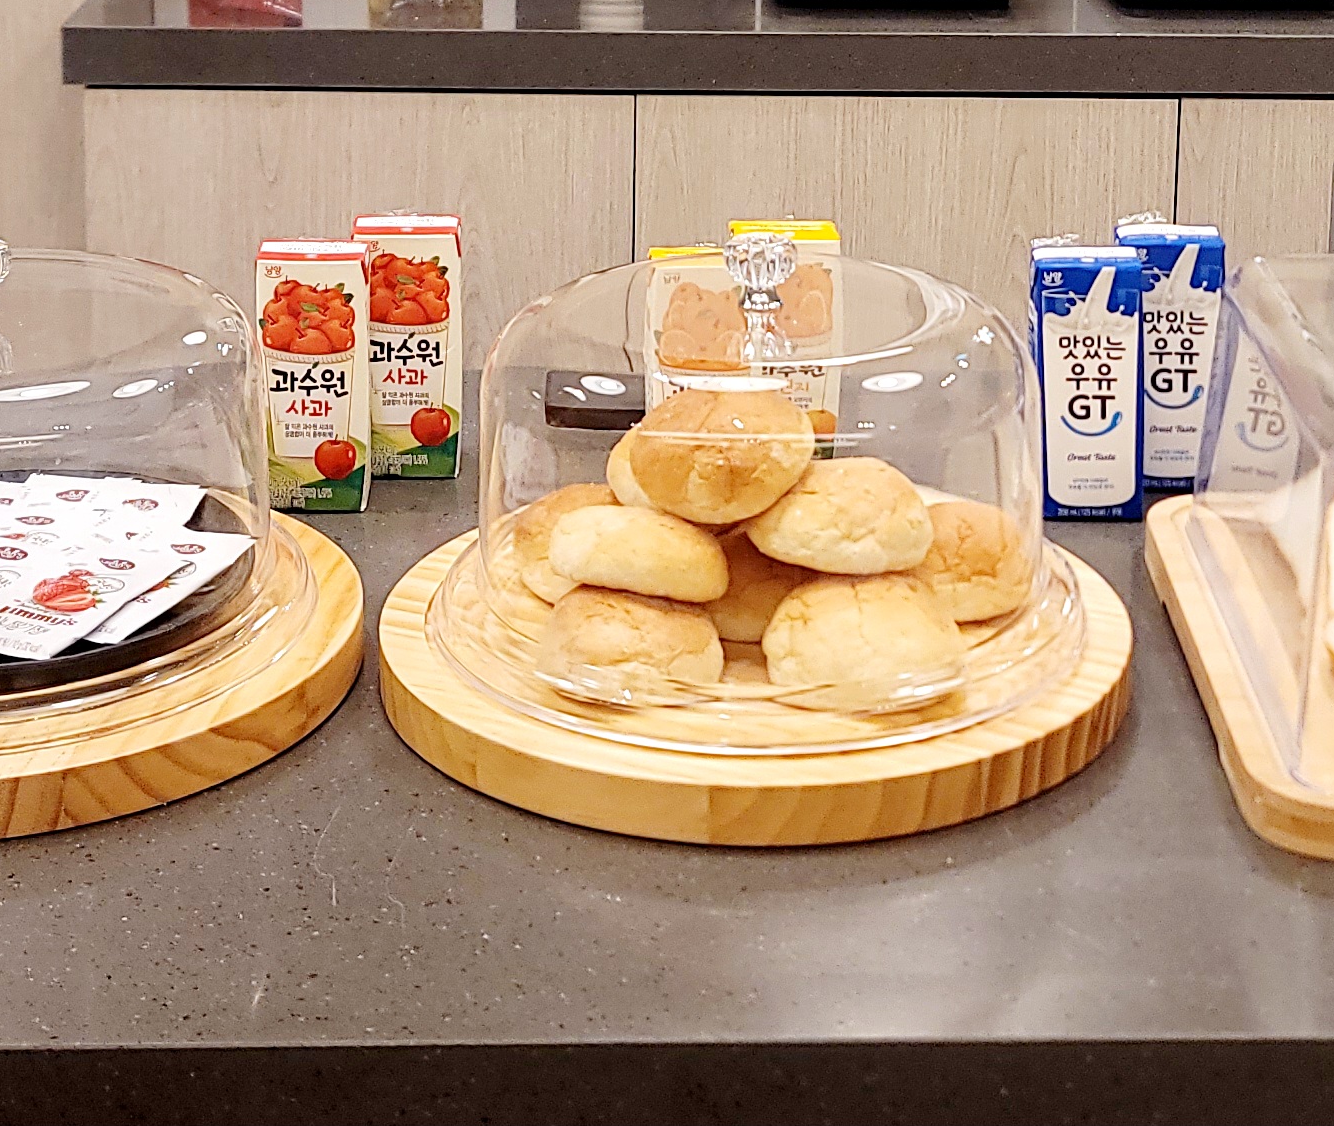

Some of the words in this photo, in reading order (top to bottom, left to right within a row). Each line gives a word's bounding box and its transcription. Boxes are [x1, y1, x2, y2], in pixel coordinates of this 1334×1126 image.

[1142, 310, 1208, 335] 맛있는
[369, 338, 444, 367] 과수원
[1058, 335, 1126, 361] 맛있는
[1148, 337, 1200, 365] 우유
[269, 367, 349, 397] 과수원
[382, 367, 428, 387] 사과
[1065, 363, 1117, 391] 우유
[1150, 368, 1198, 393] GT
[284, 399, 333, 418] 사과
[1067, 395, 1116, 420] GT
